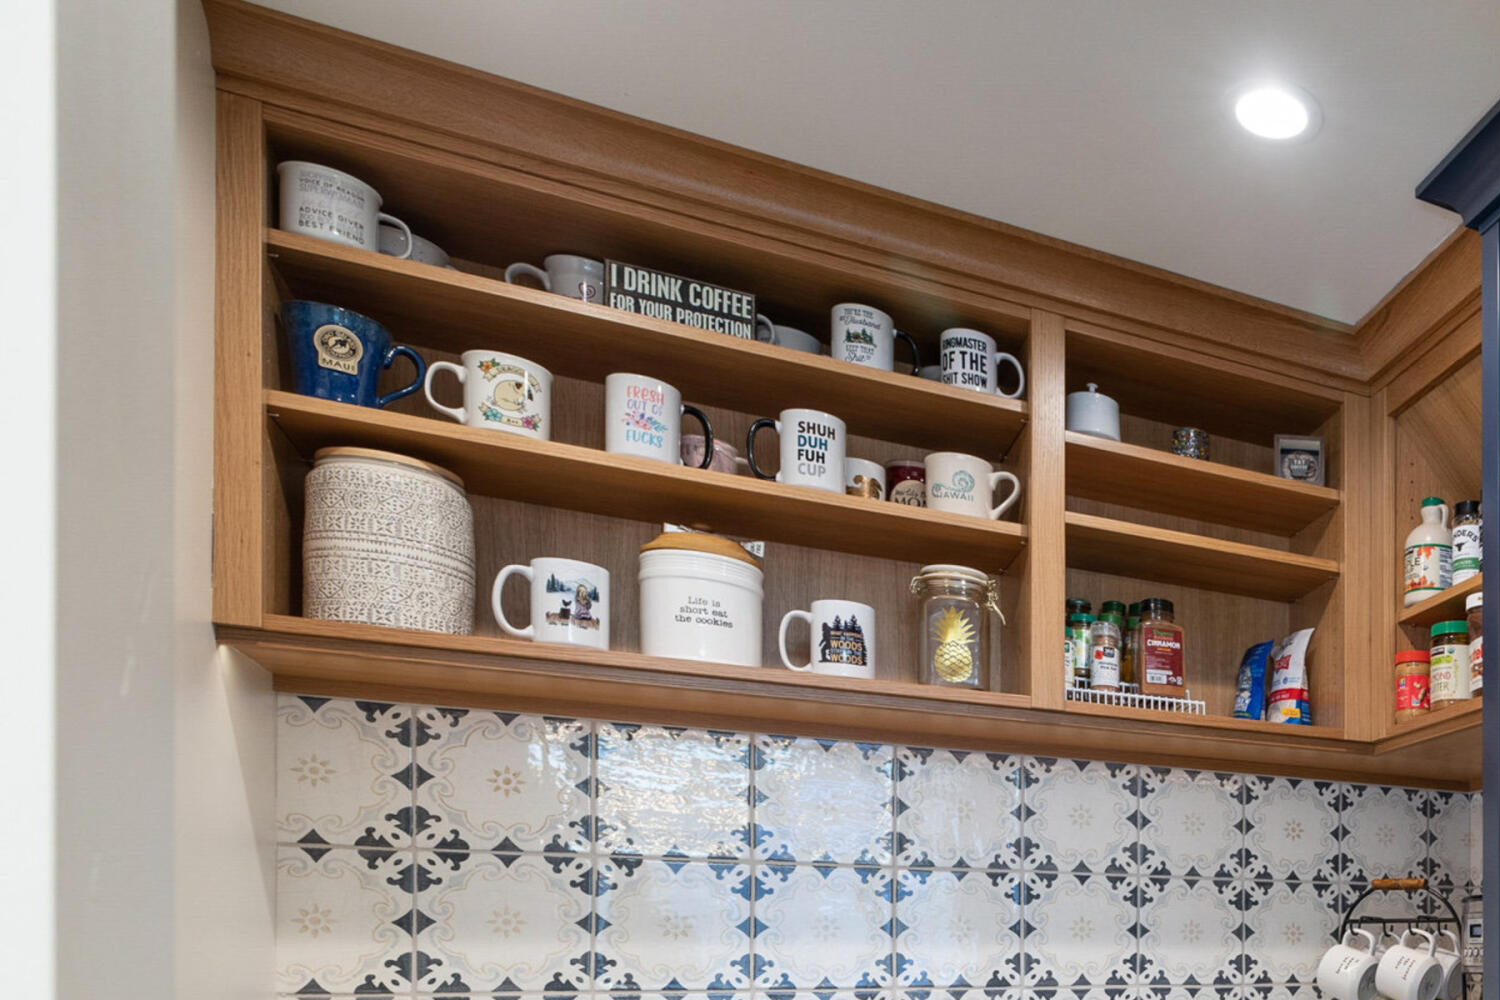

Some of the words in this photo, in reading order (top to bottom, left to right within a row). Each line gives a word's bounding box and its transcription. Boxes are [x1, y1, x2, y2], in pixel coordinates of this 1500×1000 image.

[299, 205, 333, 218] ADVICE
[298, 220, 323, 229] BEST
[610, 263, 618, 288] I
[624, 266, 683, 303] DRINK
[688, 283, 752, 319] COFFEE
[610, 292, 635, 313] FOR
[638, 298, 673, 323] YOUR
[675, 307, 752, 340] PROTECTION
[322, 358, 357, 372] MAUI
[943, 350, 956, 372] OF
[959, 350, 988, 375] THE
[943, 372, 958, 385] SHIT
[961, 372, 988, 389] SHOW
[626, 385, 665, 406] FRESH
[626, 399, 647, 411] OUT
[797, 421, 836, 440] SHUH
[625, 429, 664, 449] FUCKS
[797, 434, 829, 451] DUH
[797, 449, 826, 464] FUH
[797, 462, 827, 478] CUP
[687, 596, 708, 606] Life
[711, 599, 721, 608] is
[679, 605, 709, 616] short
[712, 610, 728, 619] eat
[674, 614, 692, 623] the
[695, 616, 734, 629] cookies
[830, 639, 863, 651] WOODS
[1146, 639, 1181, 650] CINNAMON
[830, 653, 863, 665] WOODS
